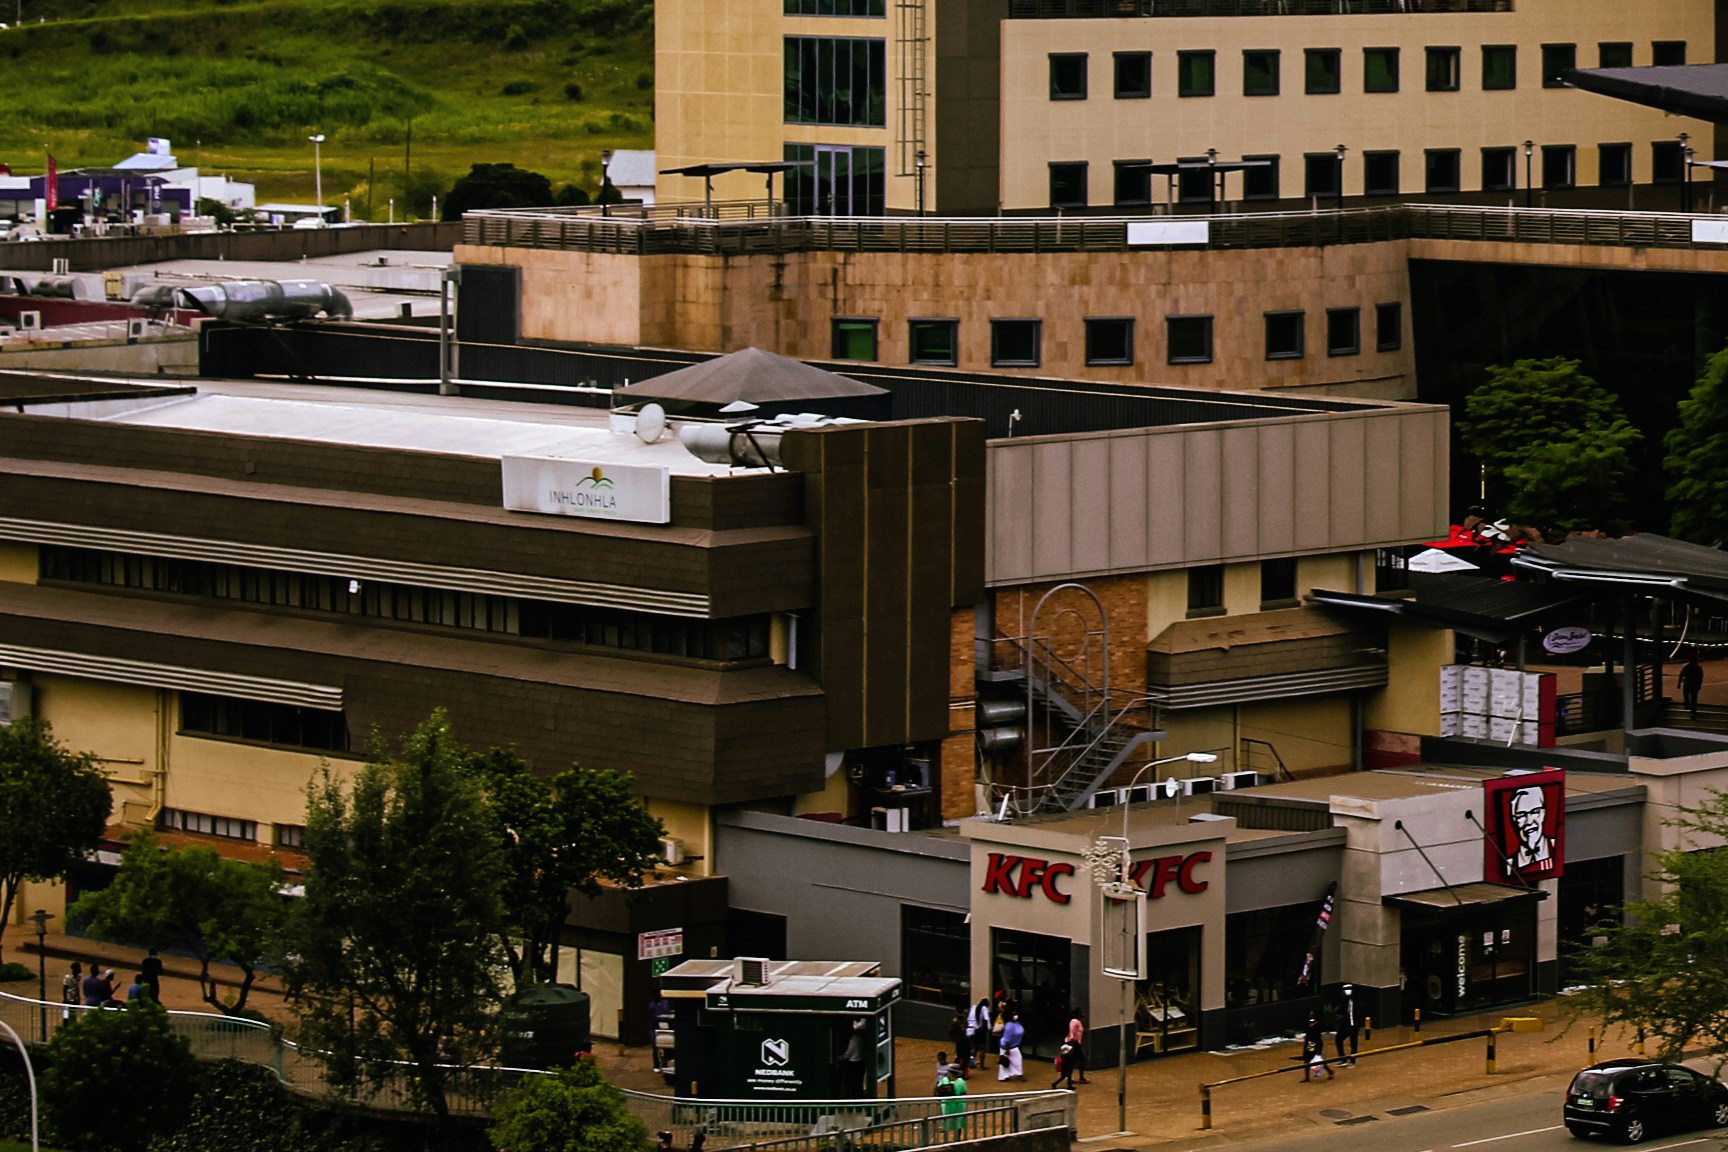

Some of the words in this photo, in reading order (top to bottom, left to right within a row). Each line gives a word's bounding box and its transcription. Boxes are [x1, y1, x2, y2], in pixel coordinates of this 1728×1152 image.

[549, 490, 616, 508] INHLONHLA
[982, 853, 1074, 905] KFC
[1112, 851, 1213, 904] KFC
[1457, 935, 1466, 997] welcome
[846, 1000, 868, 1008] ATM
